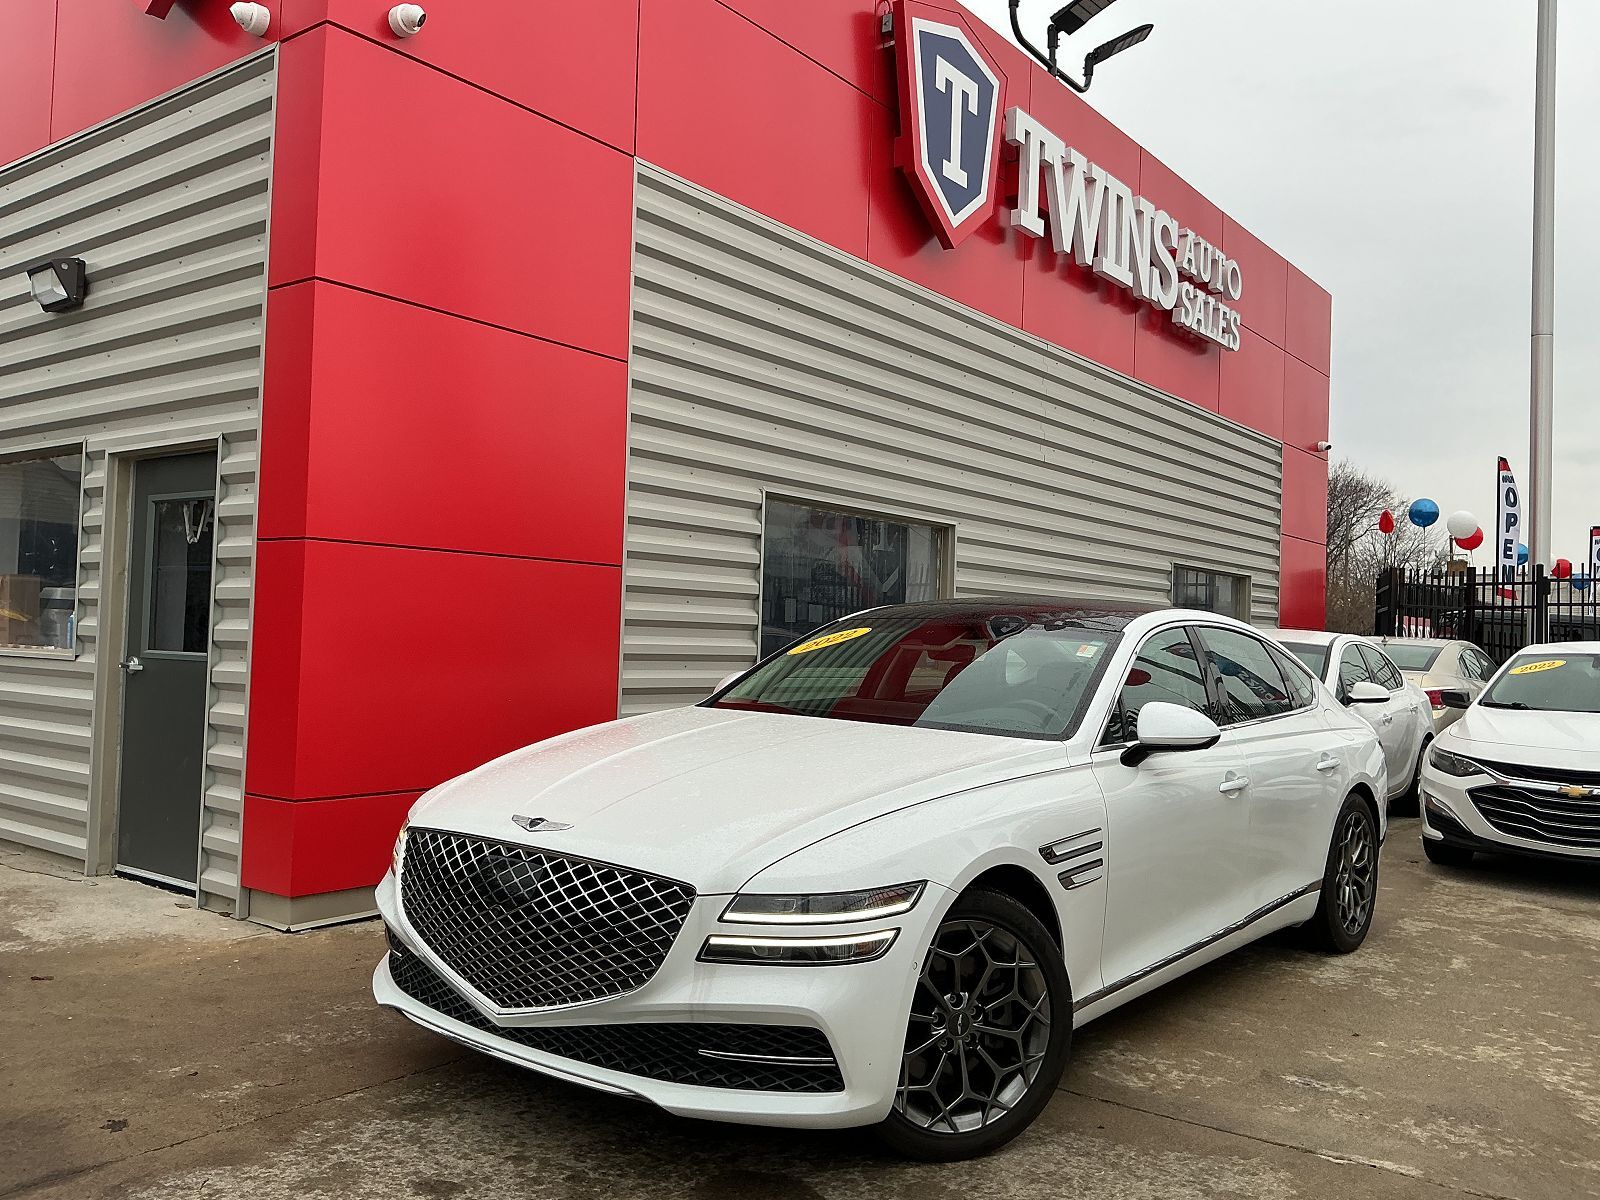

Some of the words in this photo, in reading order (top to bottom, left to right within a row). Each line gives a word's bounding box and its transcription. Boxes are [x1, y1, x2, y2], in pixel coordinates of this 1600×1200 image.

[935, 54, 979, 189] T
[1006, 107, 1179, 311] TWINS
[1176, 227, 1243, 301] AUTO
[1172, 282, 1241, 352] SALES
[1520, 661, 1556, 672] 2022
